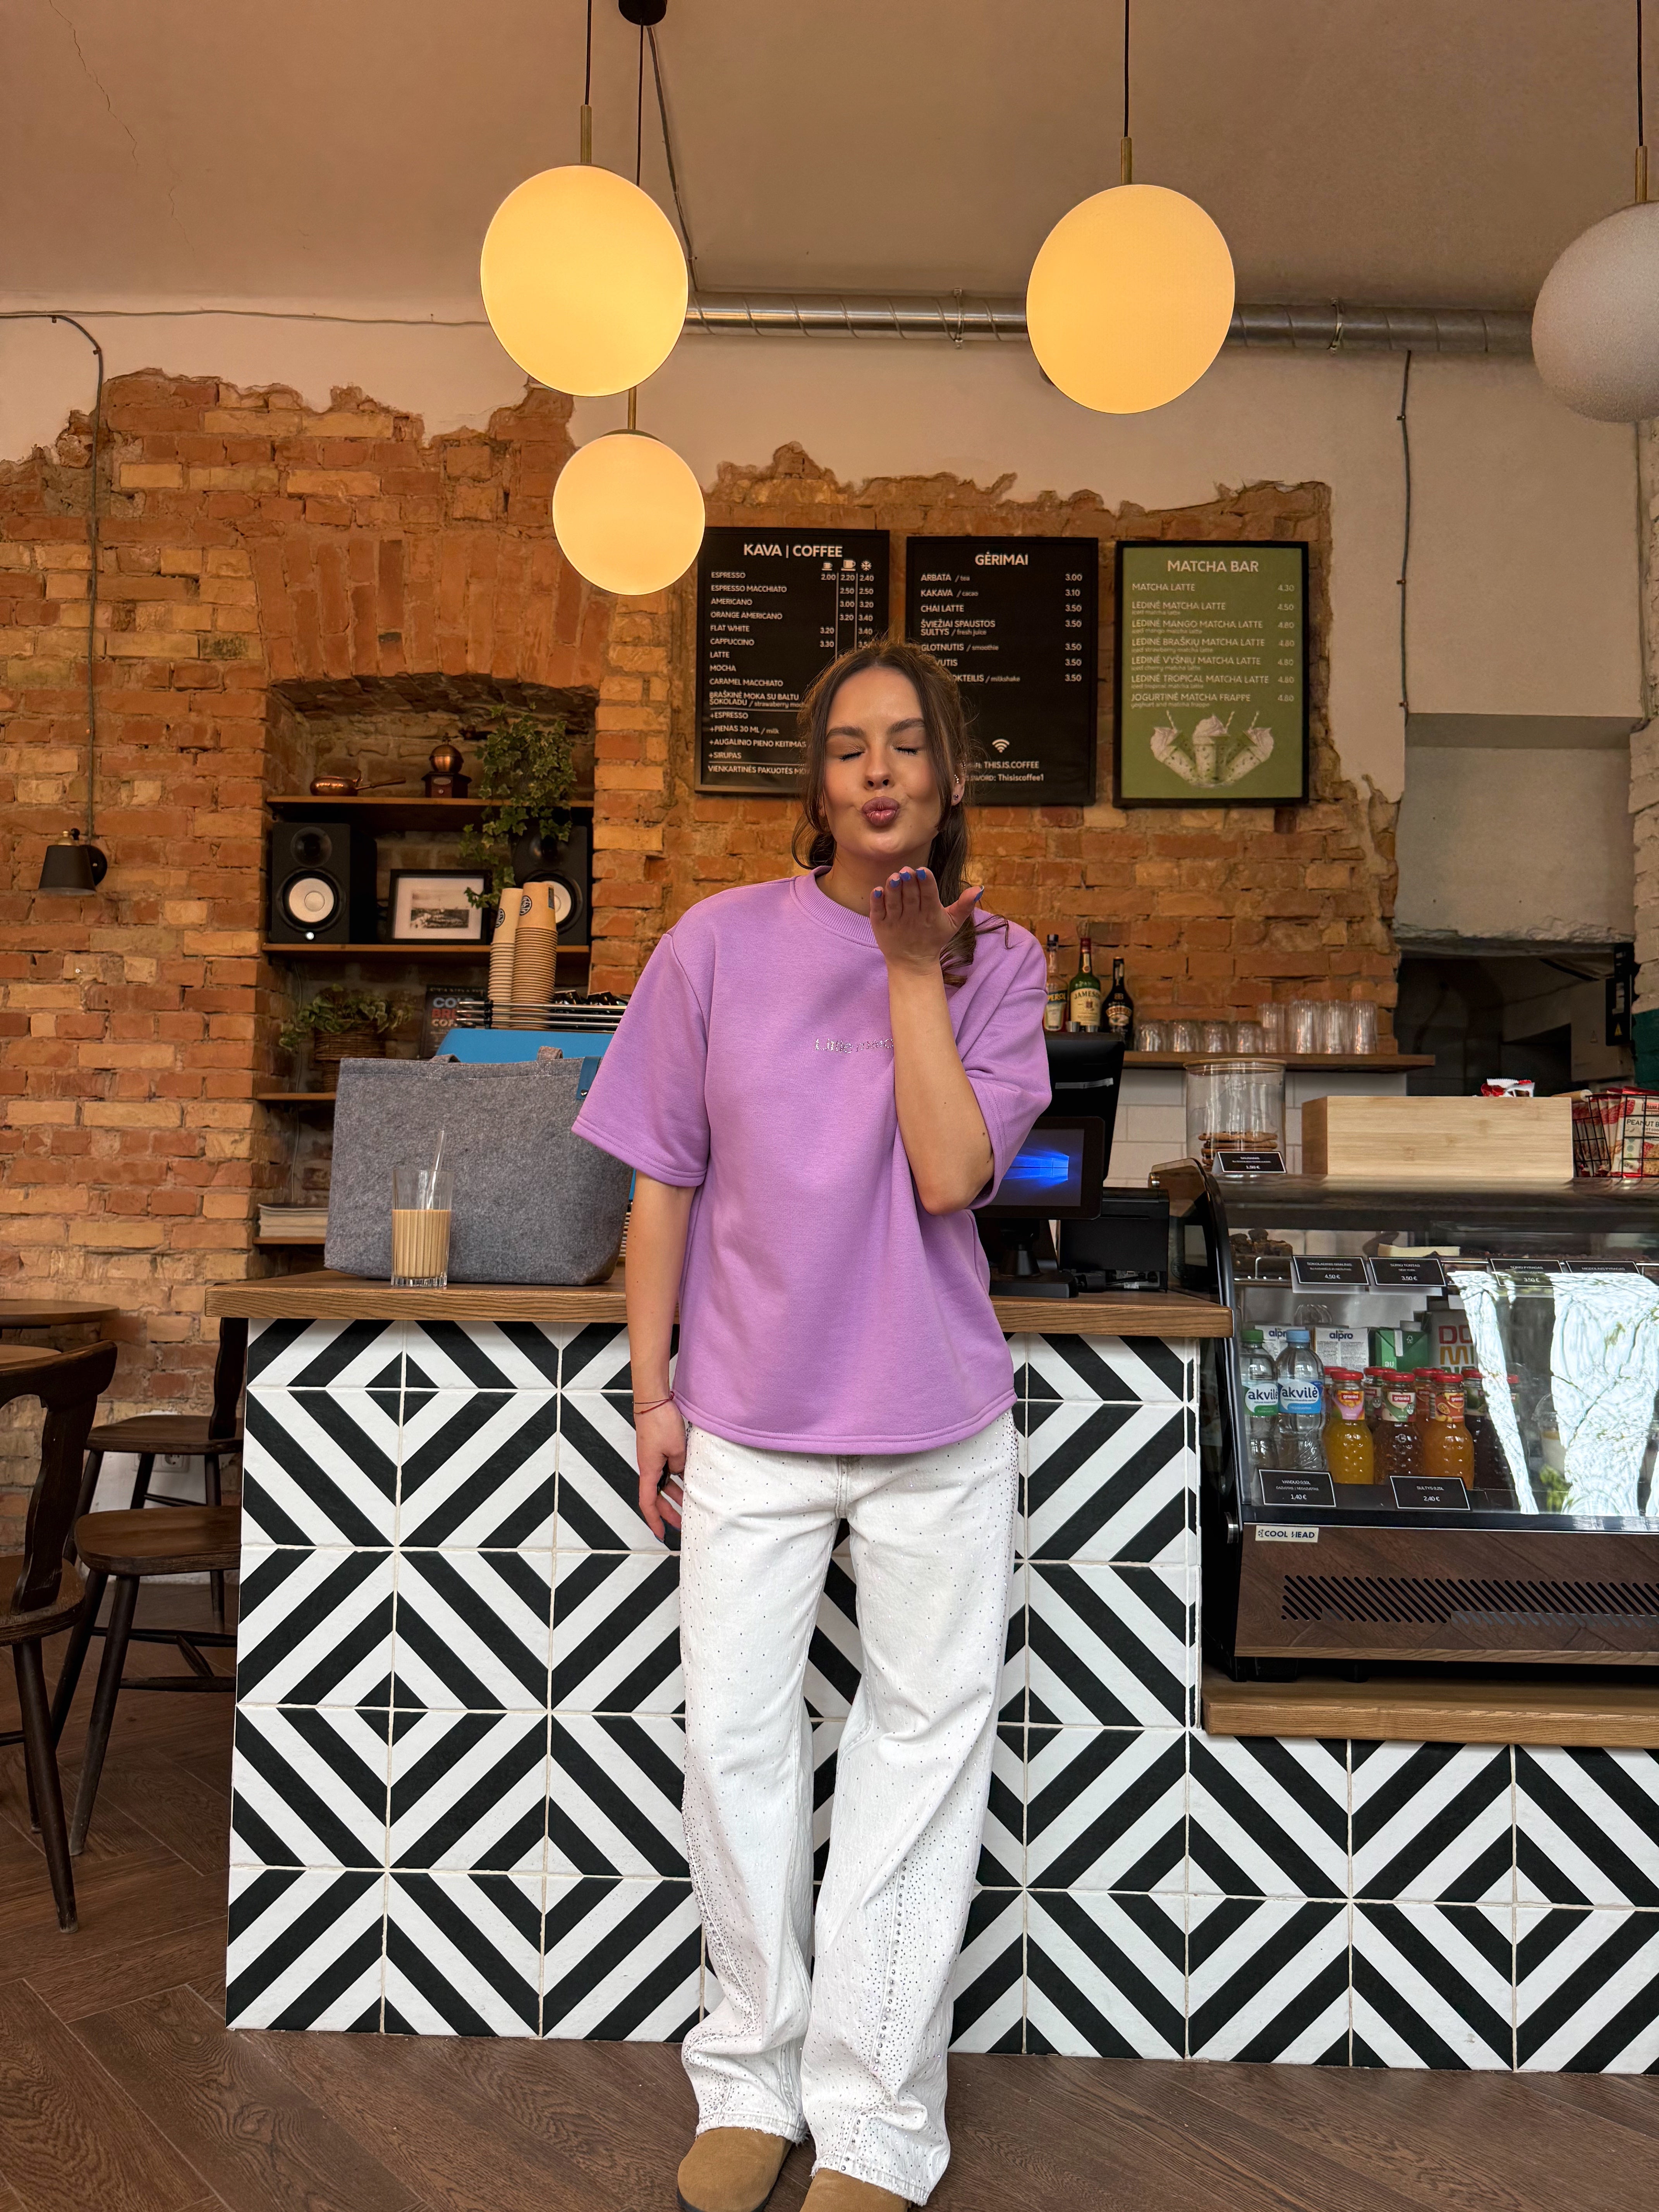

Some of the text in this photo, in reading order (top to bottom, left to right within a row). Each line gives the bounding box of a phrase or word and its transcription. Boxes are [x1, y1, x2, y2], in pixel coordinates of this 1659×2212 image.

[744, 544, 782, 556] KAVA
[793, 545, 842, 557] COFFEE
[975, 552, 1028, 565] GĖRIMAI
[1168, 560, 1259, 573] MATCHA BAR
[1132, 601, 1161, 609] LEDINĖ
[1132, 619, 1161, 627] LEDINĖ
[1132, 637, 1161, 646] LEDINĖ
[1132, 656, 1160, 664] LEDINĖ
[1132, 674, 1160, 682] LEDINĖ
[1269, 1328, 1286, 1339] alpr
[1329, 1331, 1353, 1341] alpro
[1282, 1387, 1318, 1398] akvilė
